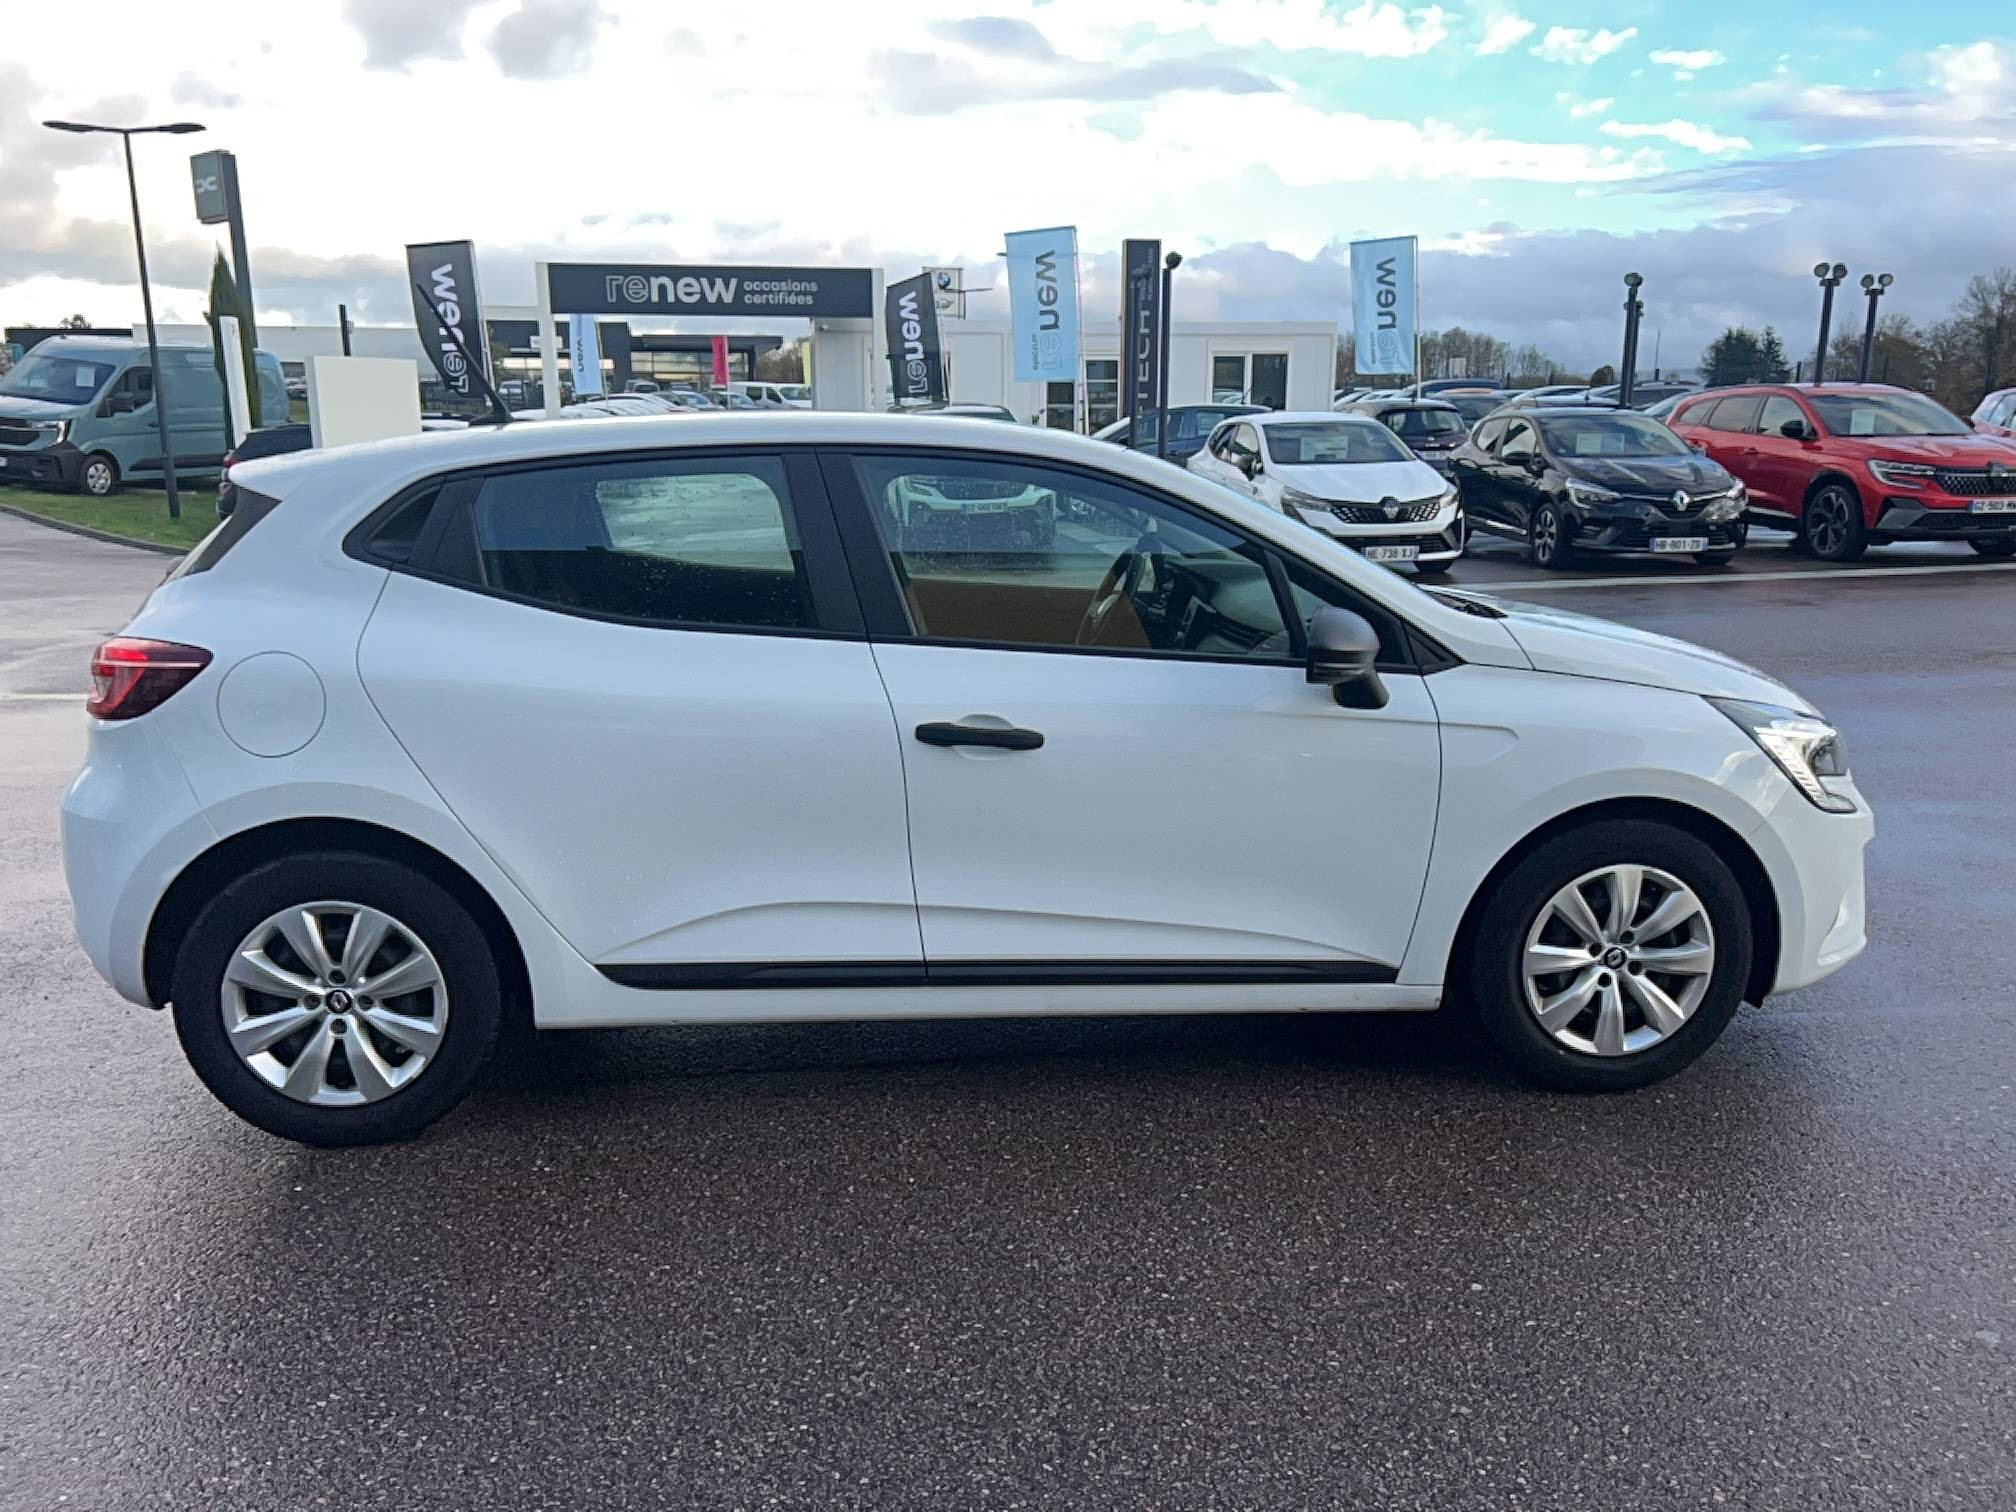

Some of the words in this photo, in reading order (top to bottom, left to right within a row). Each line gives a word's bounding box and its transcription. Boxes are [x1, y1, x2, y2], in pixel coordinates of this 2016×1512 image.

[605, 275, 738, 304] renew
[743, 278, 818, 292] occasions
[744, 291, 814, 305] certifiées
